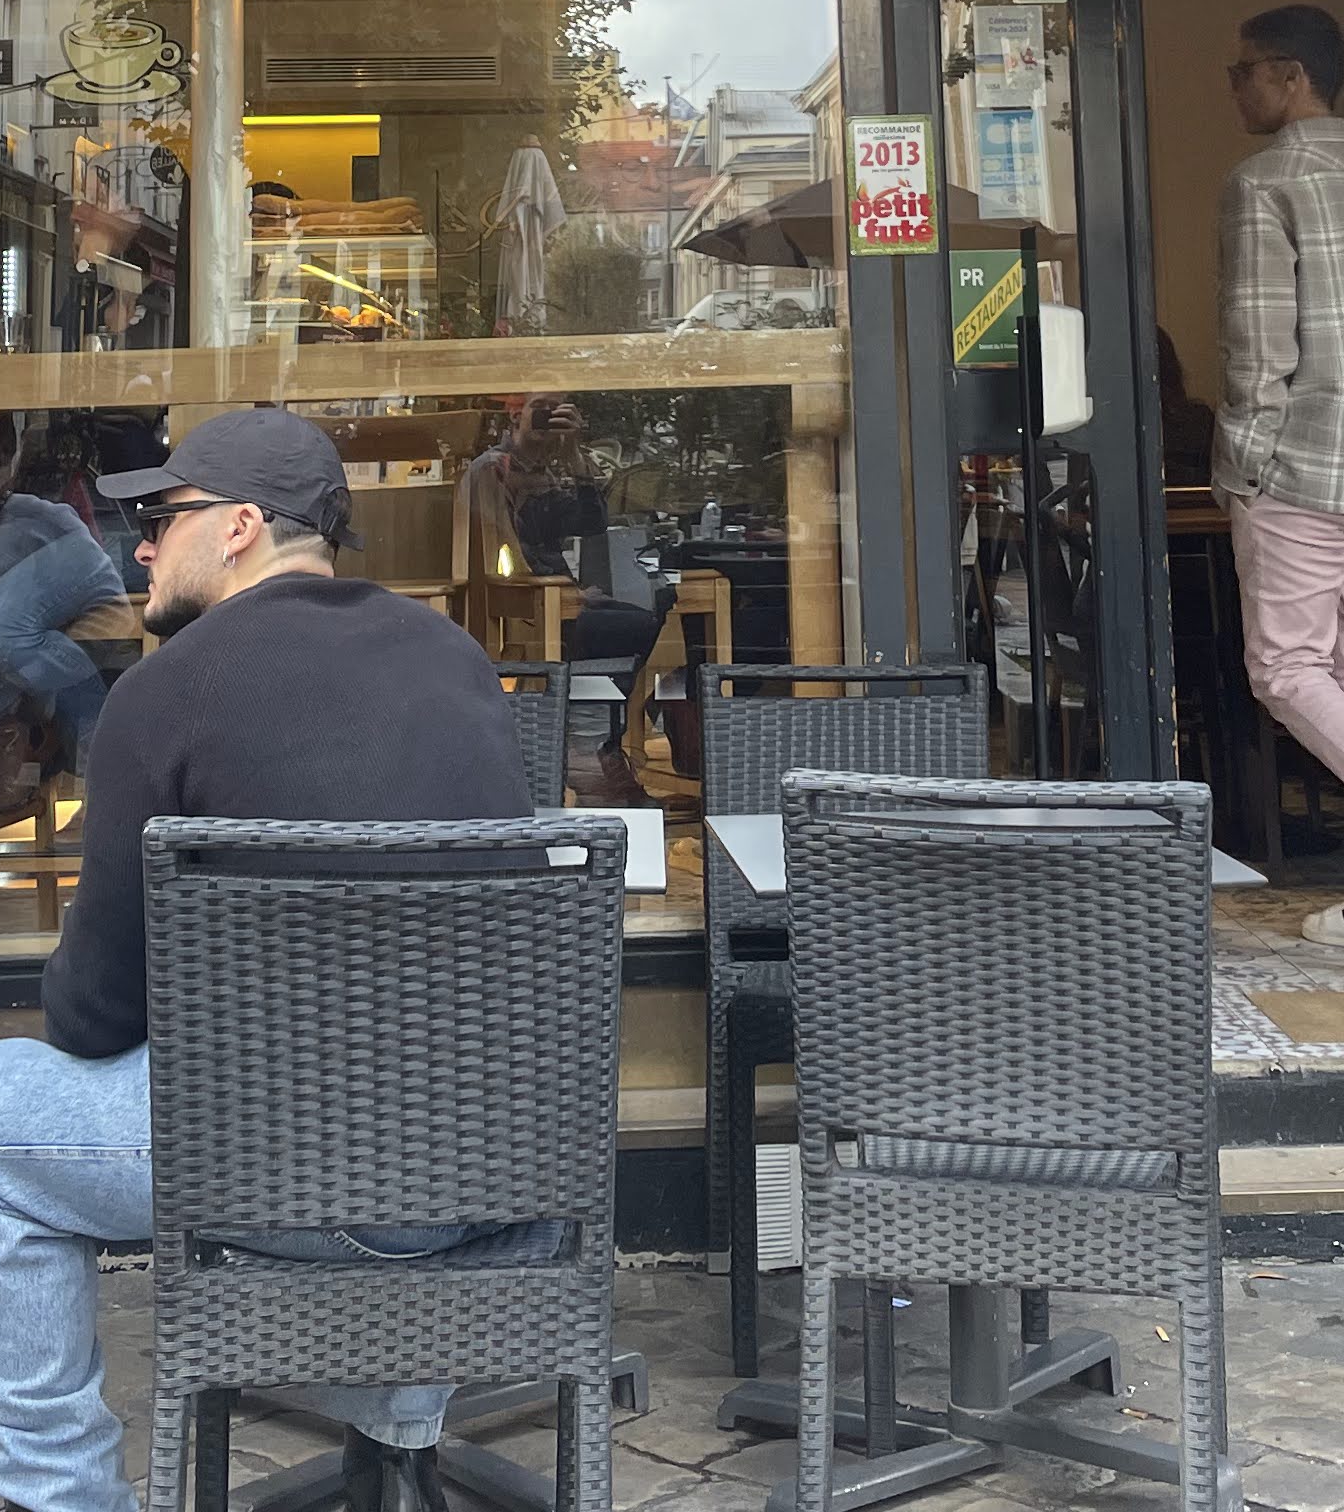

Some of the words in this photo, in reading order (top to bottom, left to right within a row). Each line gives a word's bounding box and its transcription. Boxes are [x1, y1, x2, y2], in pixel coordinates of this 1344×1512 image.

[857, 125, 921, 135] RECOMMANDÉ
[859, 141, 921, 167] 2013
[851, 191, 933, 226] petit
[864, 219, 935, 245] futé
[959, 268, 985, 287] PR
[956, 267, 1021, 356] RESTAURAN
